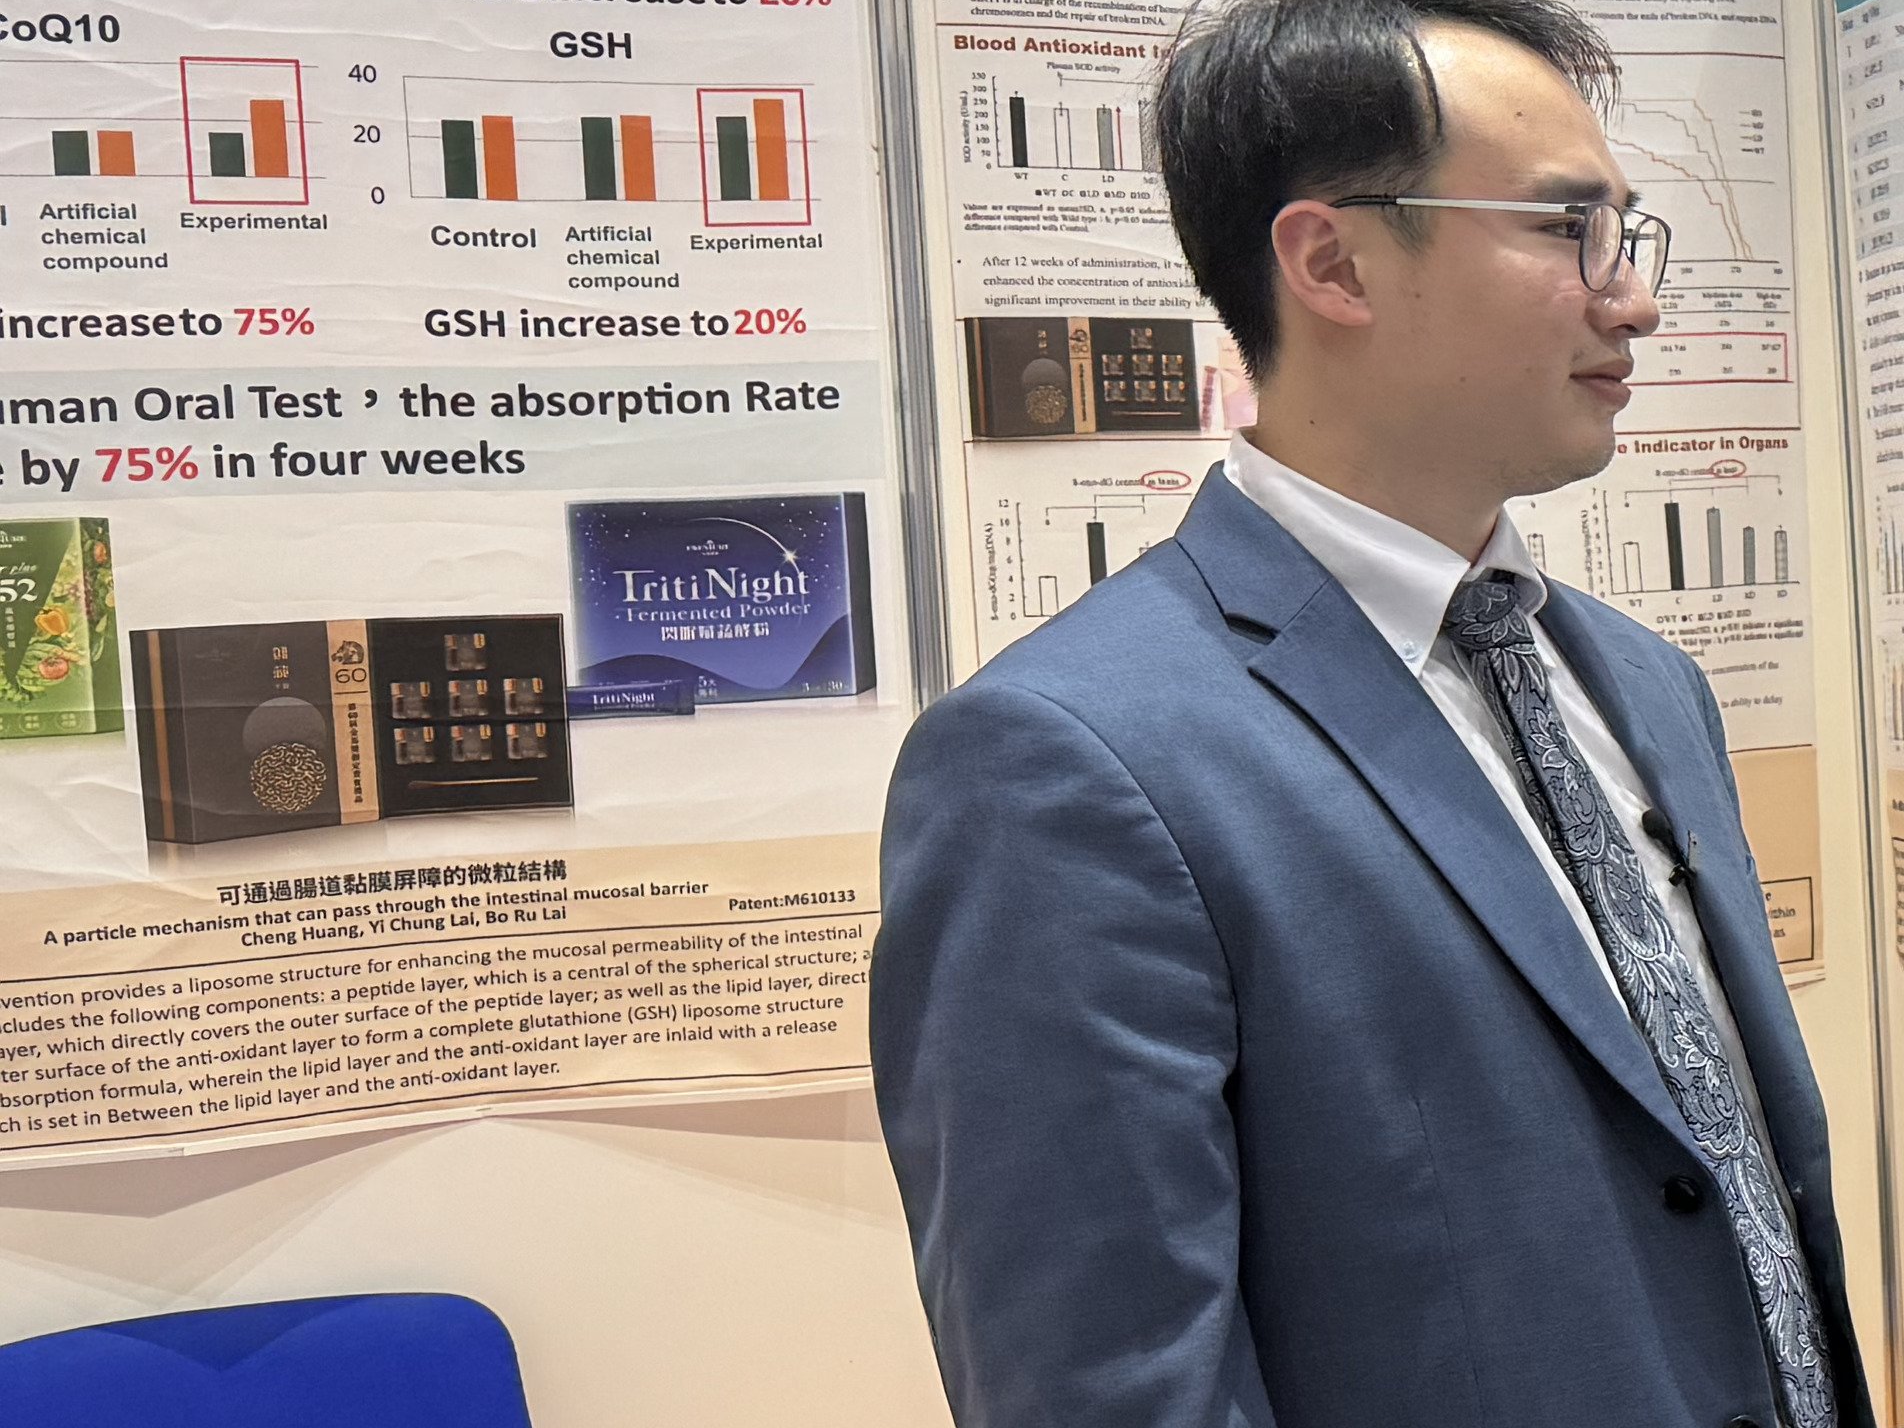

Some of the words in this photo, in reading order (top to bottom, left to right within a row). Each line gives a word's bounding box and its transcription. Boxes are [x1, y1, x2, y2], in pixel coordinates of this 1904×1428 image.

[550, 31, 632, 59] GSH
[954, 35, 1016, 51] Blood
[1024, 37, 1146, 58] Antioxidant
[348, 64, 377, 83] 40
[353, 124, 380, 143] 20
[371, 186, 385, 205] 0
[39, 203, 136, 220] Artificial
[180, 212, 327, 232] Experimental
[41, 228, 146, 244] chemical
[431, 225, 536, 248] Control
[565, 226, 651, 242] Artificial
[690, 233, 822, 253] Experimental
[43, 253, 168, 273] compound
[567, 249, 659, 265] chemical
[568, 273, 679, 291] compound
[985, 294, 1041, 307] significant
[1045, 296, 1115, 307] improvement
[1119, 297, 1129, 306] in
[1133, 296, 1155, 307] their
[1160, 297, 1191, 309] ability
[233, 306, 315, 337] 75%
[425, 309, 505, 337] GSH
[520, 308, 680, 337] increase
[690, 311, 729, 336] to
[734, 308, 806, 334] 20%
[135, 384, 234, 421] Oral
[399, 383, 475, 417] the
[491, 382, 730, 423] absorption
[746, 381, 839, 412] Rate
[1634, 439, 1713, 454] Indicator
[1720, 437, 1734, 450] in
[1739, 436, 1788, 451] Organs
[23, 453, 79, 491] by
[95, 448, 199, 483] 75%
[214, 444, 255, 478] in
[271, 443, 367, 477] four
[380, 442, 525, 476] weeks
[612, 567, 809, 603] TritiNight
[627, 605, 731, 622] Fermented
[740, 603, 811, 618] Powder
[335, 668, 367, 683] 60
[729, 890, 856, 912] Patent:M610133
[44, 931, 58, 945] A
[63, 925, 136, 946] particle
[143, 915, 249, 936] mechanism
[255, 911, 291, 925] that
[297, 909, 326, 921] can
[333, 905, 371, 921] pass
[376, 896, 445, 914] through
[451, 894, 480, 908] the
[486, 887, 567, 905] intestinal
[574, 883, 644, 900] mucosal
[650, 881, 709, 896] barrier
